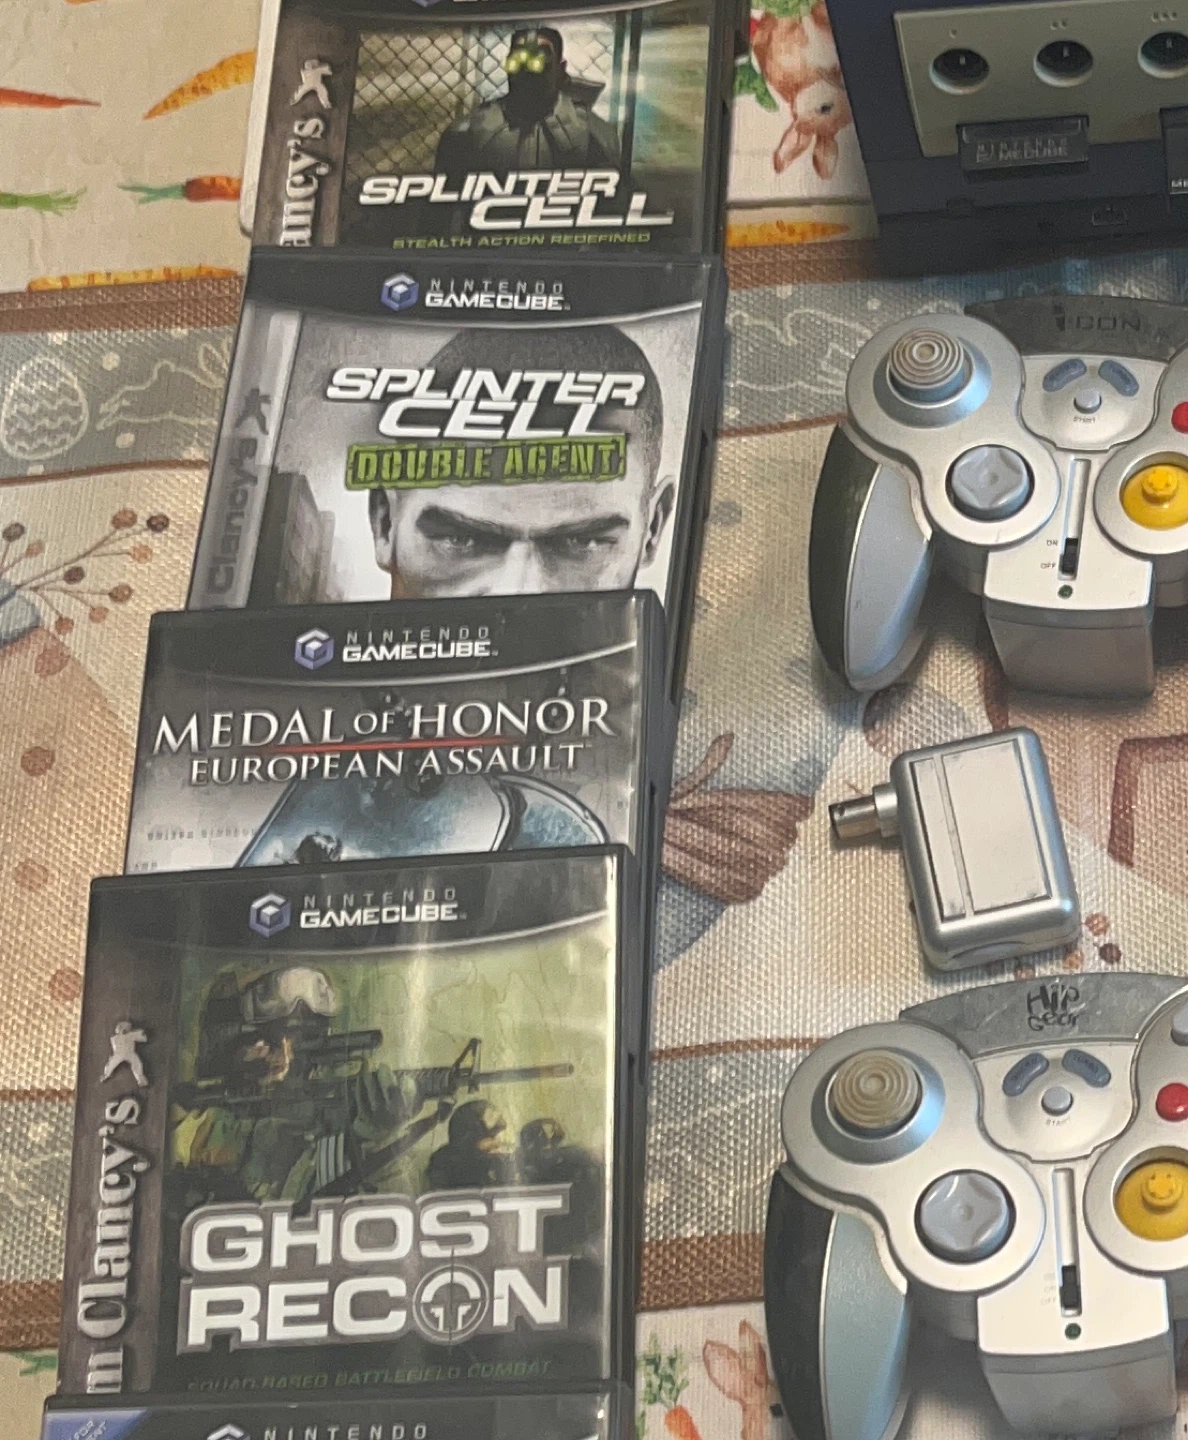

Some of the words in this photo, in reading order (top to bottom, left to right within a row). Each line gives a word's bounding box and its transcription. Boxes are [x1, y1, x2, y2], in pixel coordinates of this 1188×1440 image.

[358, 168, 621, 206] SPLINTER
[469, 192, 675, 231] CELL
[392, 234, 473, 250] STEALTH
[477, 232, 545, 248] ACTION
[550, 231, 651, 246] REDEFINED
[424, 291, 566, 311] GAMECUBE
[430, 278, 564, 295] NINTENDO
[325, 367, 647, 407] SPLINTER
[378, 398, 628, 440] CELL
[354, 446, 492, 484] DOUBLE
[502, 442, 617, 477] AGENT
[342, 641, 492, 662] GAMECUBE
[346, 626, 489, 645] NINTENDO
[152, 708, 345, 756] MEDAL
[353, 709, 396, 735] OF
[409, 697, 617, 741] HONOR
[190, 750, 403, 787] EUROPEAN
[418, 743, 586, 777] ASSAULT
[299, 903, 459, 929] GAMECUBE
[302, 888, 457, 908] NINTENDO
[78, 1097, 152, 1339] Clancy's
[190, 1194, 564, 1273] GHOST
[187, 1265, 563, 1348] RECON
